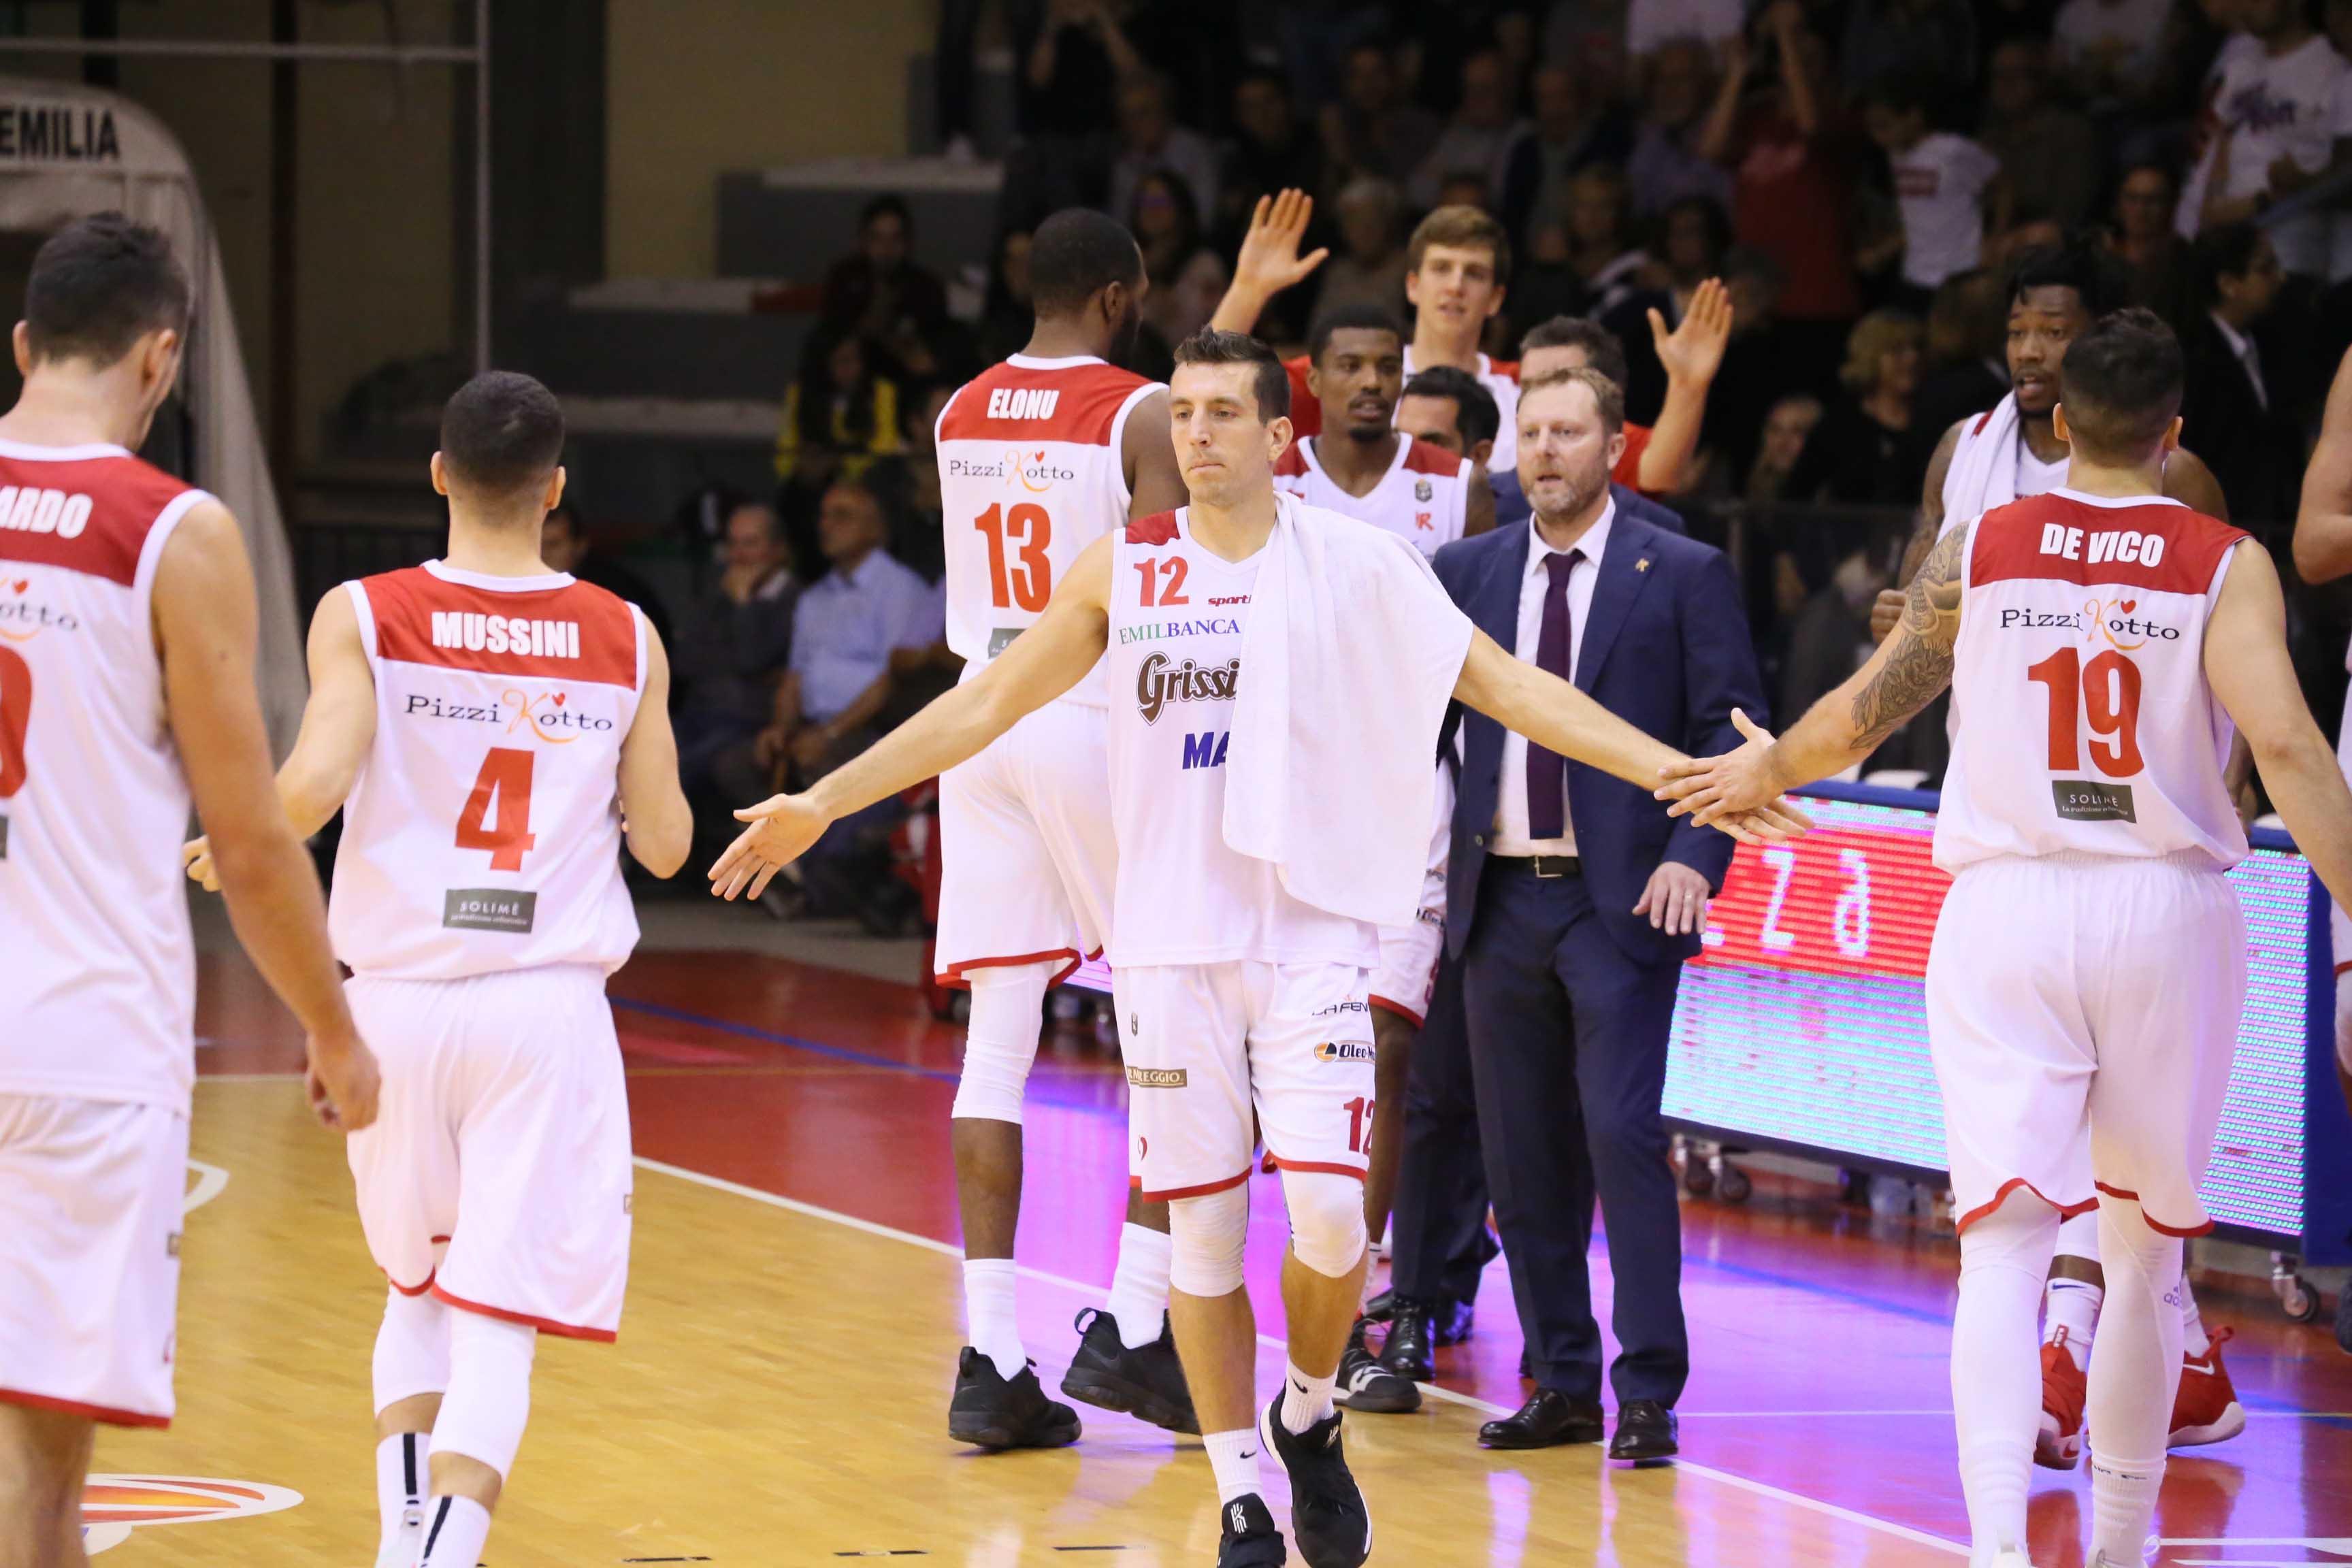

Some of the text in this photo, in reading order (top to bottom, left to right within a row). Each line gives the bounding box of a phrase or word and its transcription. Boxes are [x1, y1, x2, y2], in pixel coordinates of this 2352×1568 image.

[0, 110, 120, 158] EMILIA
[987, 389, 1060, 420] ELONU
[975, 502, 1051, 612] 13
[2040, 523, 2165, 568] DE VICO
[1133, 556, 1189, 607] 12
[431, 611, 580, 659] MUSSINI
[2027, 647, 2144, 778] 19
[455, 747, 536, 872] 4
